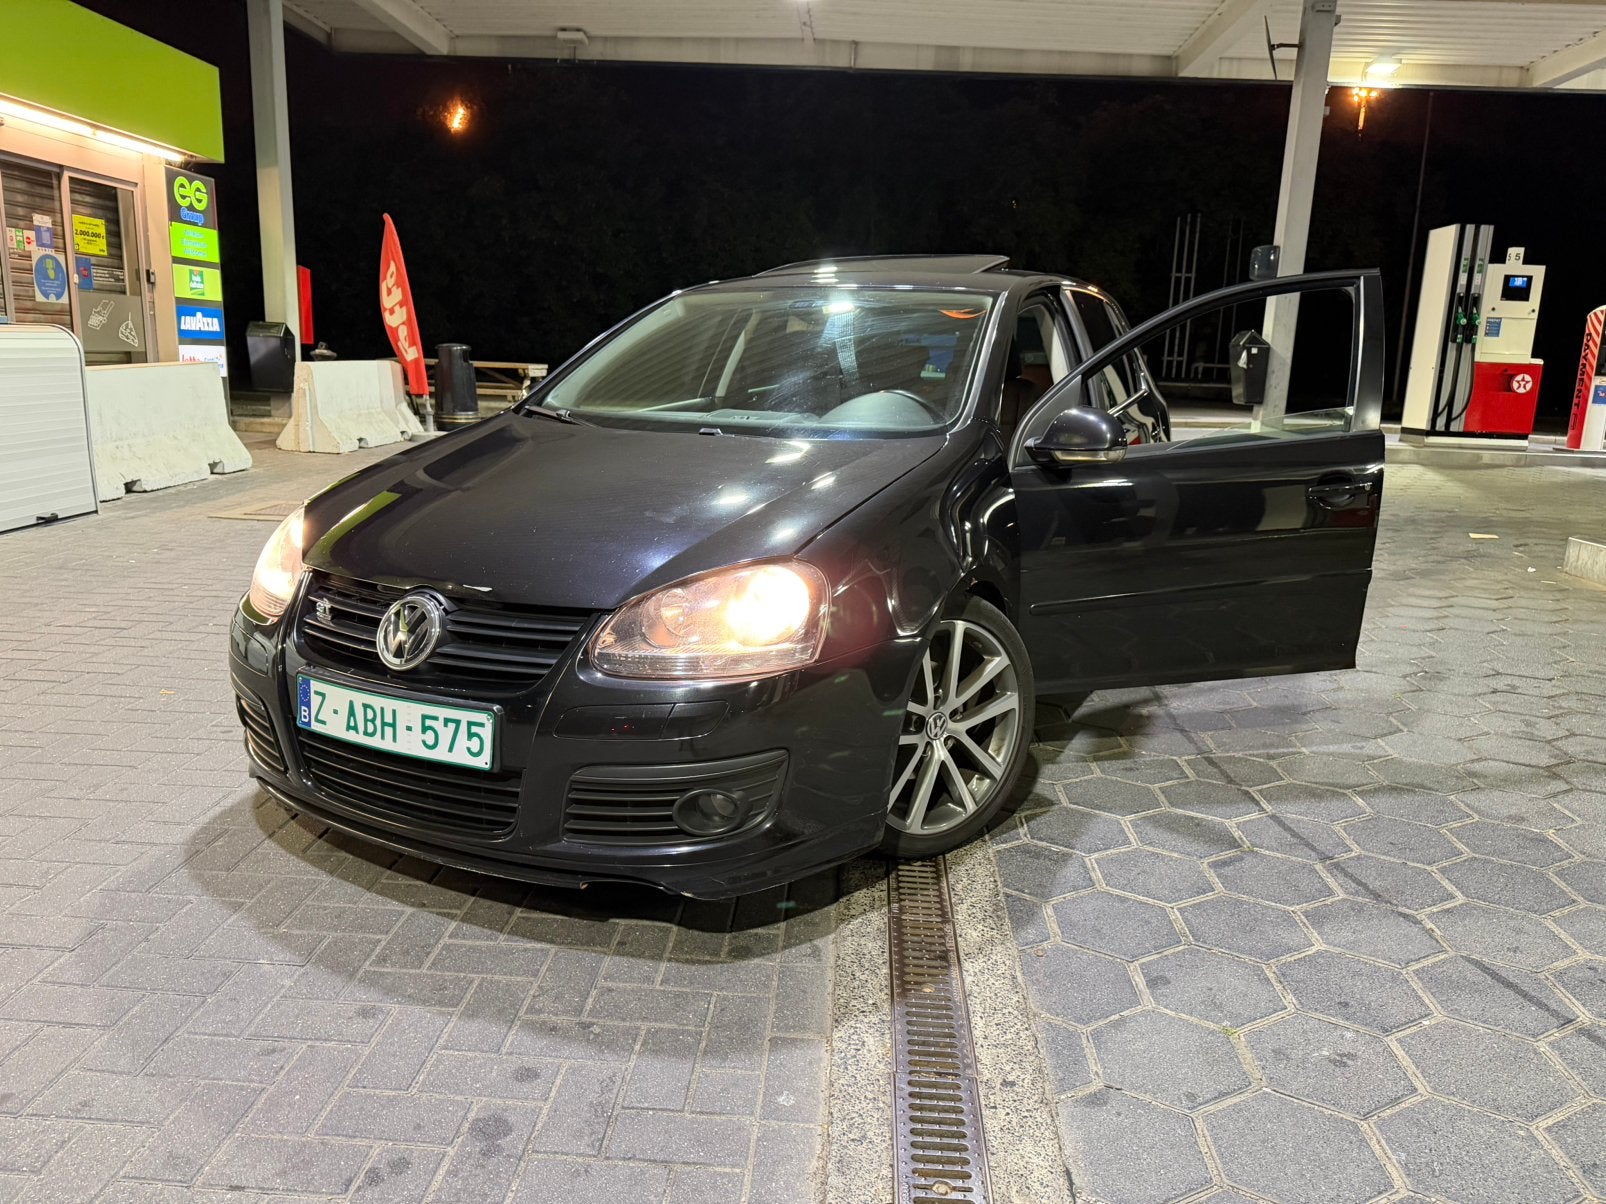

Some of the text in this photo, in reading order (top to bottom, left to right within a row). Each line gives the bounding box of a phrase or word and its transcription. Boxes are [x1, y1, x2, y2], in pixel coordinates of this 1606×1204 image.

[1514, 252, 1521, 261] 5
[180, 312, 220, 332] LAVAZZA
[1573, 332, 1593, 410] PAYMENT
[300, 706, 309, 723] B
[313, 690, 486, 758] Z-ABH-575
